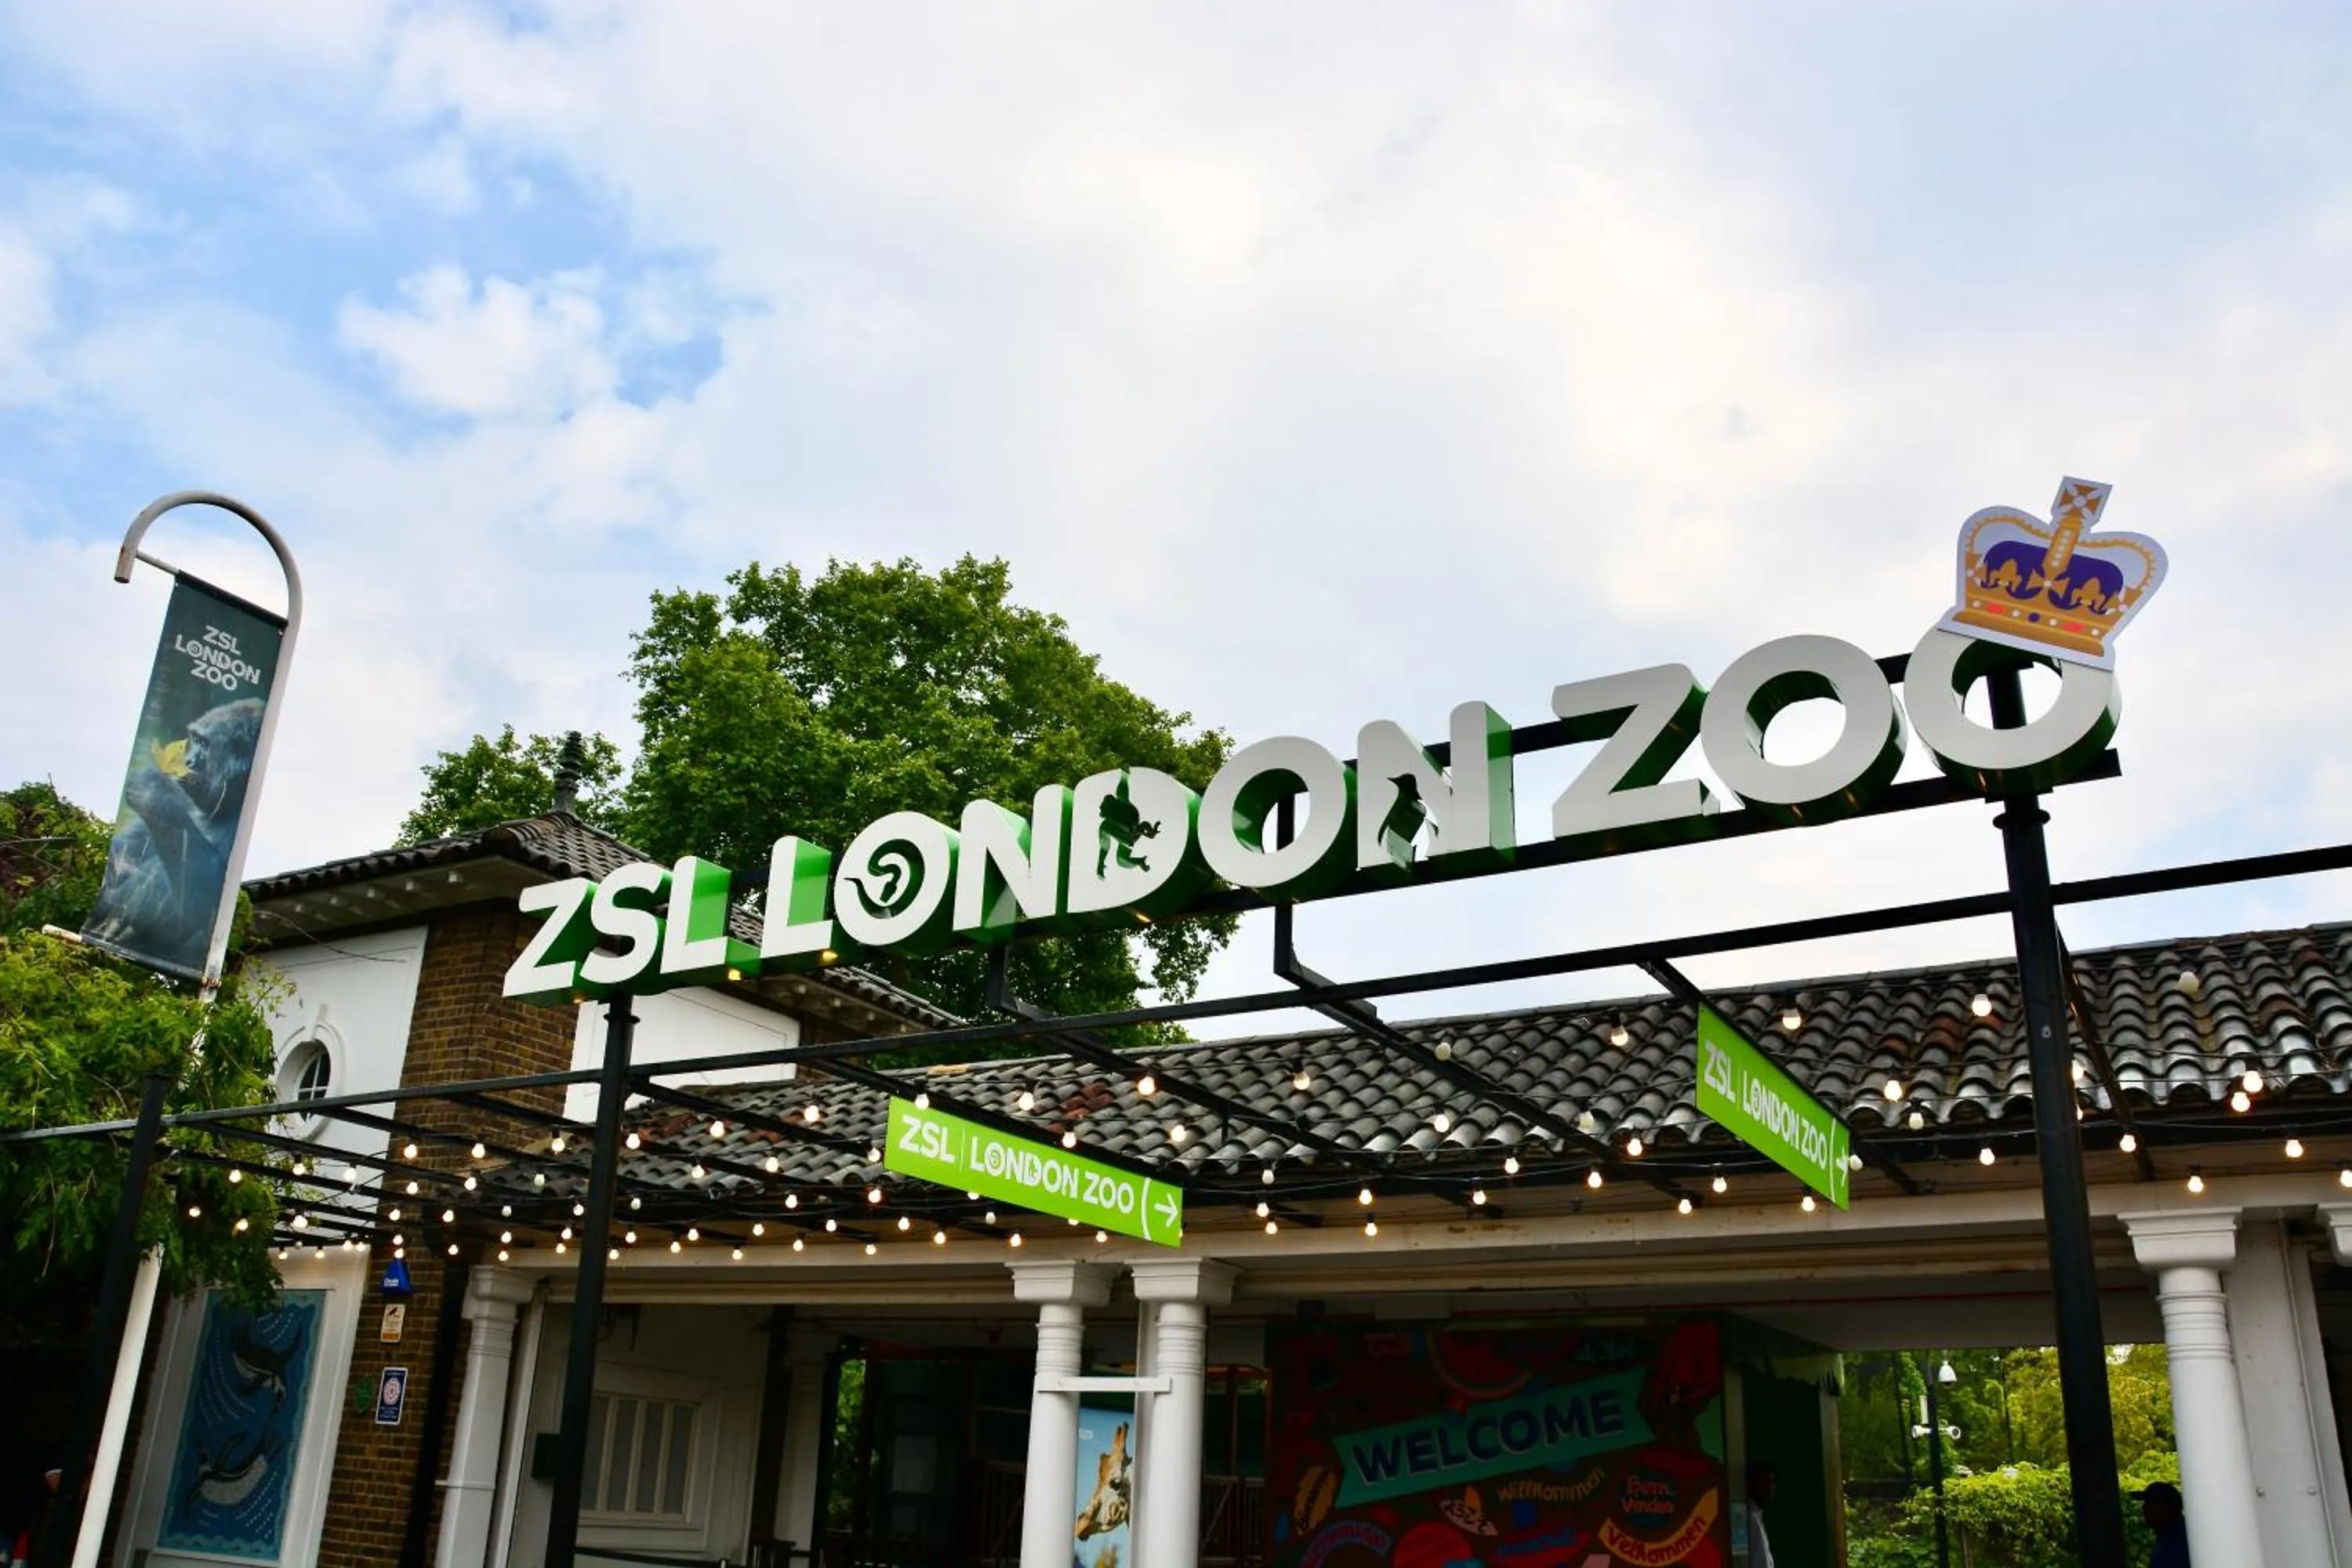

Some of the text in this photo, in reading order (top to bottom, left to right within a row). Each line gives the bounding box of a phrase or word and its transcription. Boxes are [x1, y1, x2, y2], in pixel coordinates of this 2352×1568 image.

[175, 633, 261, 684] LONDON
[191, 659, 238, 691] ZOO
[203, 625, 241, 655] ZSL
[503, 627, 2122, 998] ZSL LONDON ZOO
[1704, 1040, 1828, 1171] ZSL LONDON ZOO
[898, 1114, 1135, 1214] ZSL LONDON ZOO
[1352, 1389, 1626, 1484] WELCOME
